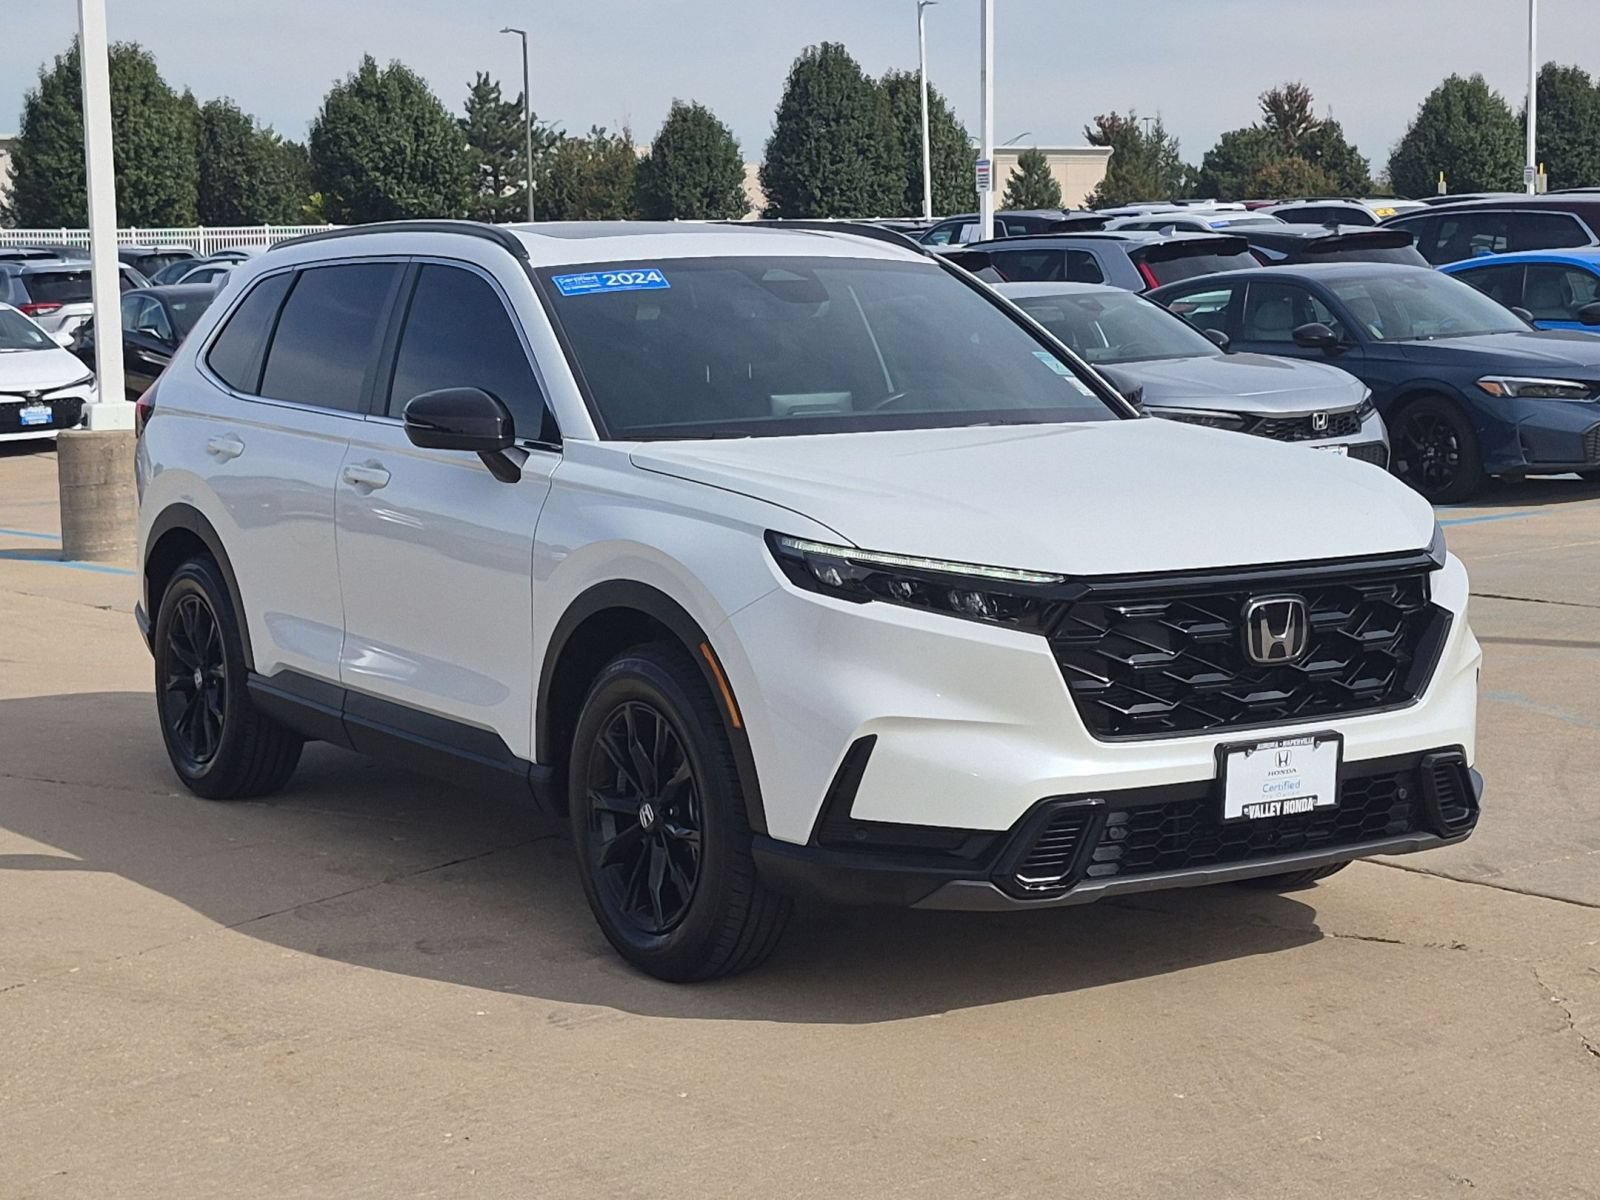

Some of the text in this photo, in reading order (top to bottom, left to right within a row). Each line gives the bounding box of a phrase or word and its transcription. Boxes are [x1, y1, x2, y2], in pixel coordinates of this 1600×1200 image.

[602, 271, 661, 285] 2024
[1267, 767, 1297, 777] HONDA
[1262, 779, 1301, 793] Certified
[1248, 798, 1314, 819] VALLEY HONDA
